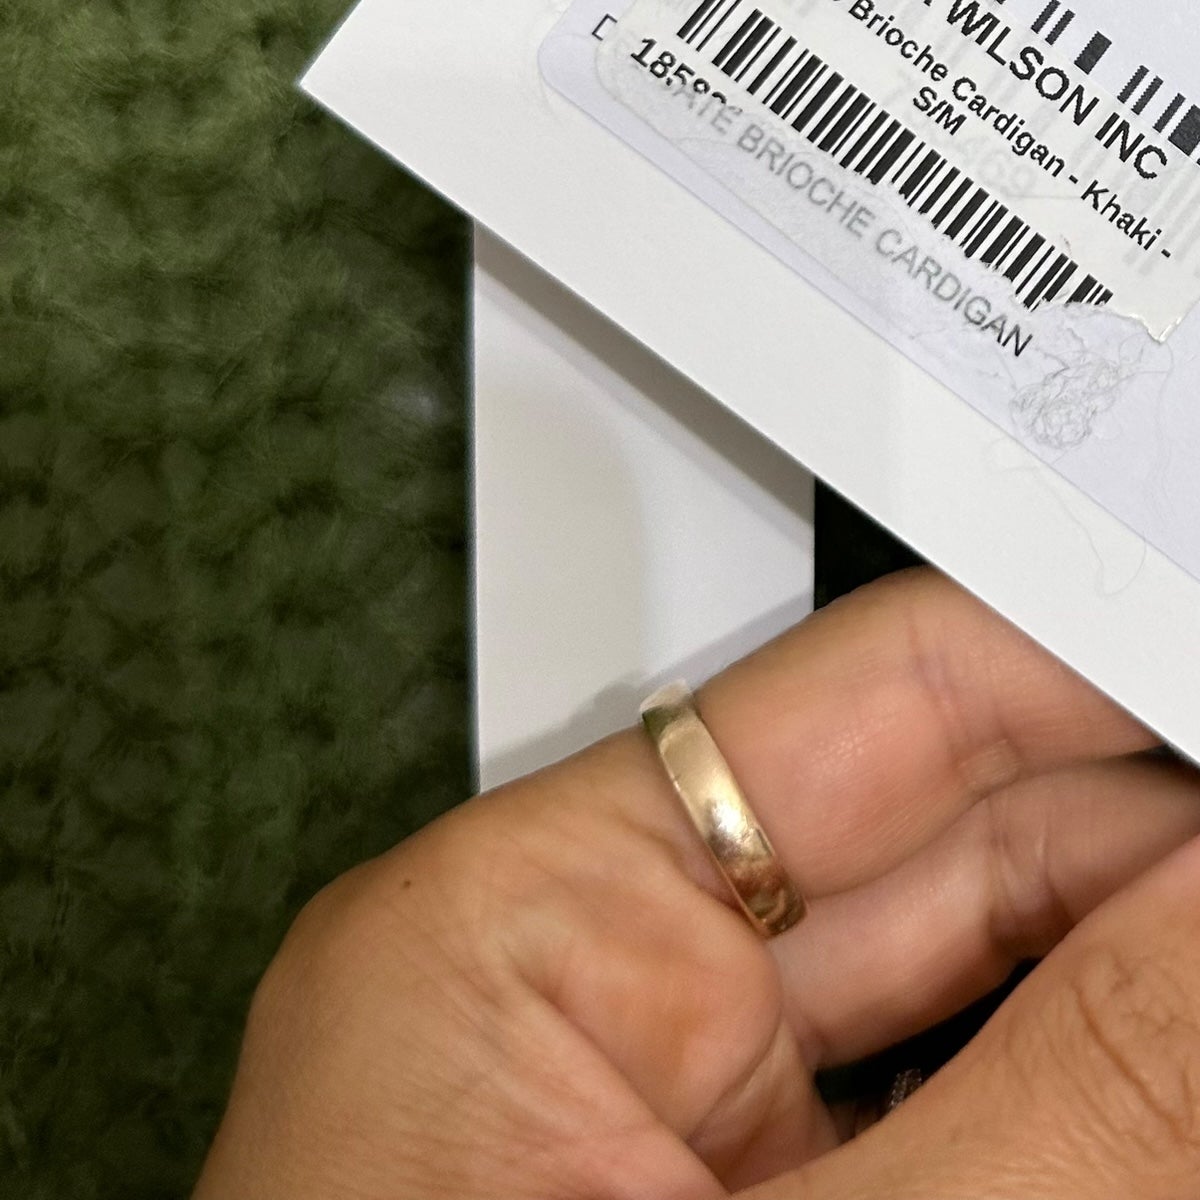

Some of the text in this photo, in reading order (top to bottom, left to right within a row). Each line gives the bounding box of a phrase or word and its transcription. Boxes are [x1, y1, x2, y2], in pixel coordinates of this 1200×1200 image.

[913, 86, 968, 136] S/M
[952, 76, 1065, 178] Cardigan
[1080, 179, 1163, 251] Khaki
[1094, 111, 1168, 180] INC
[737, 123, 877, 240] BRIOCHE
[875, 228, 1034, 358] CARDIGAN
